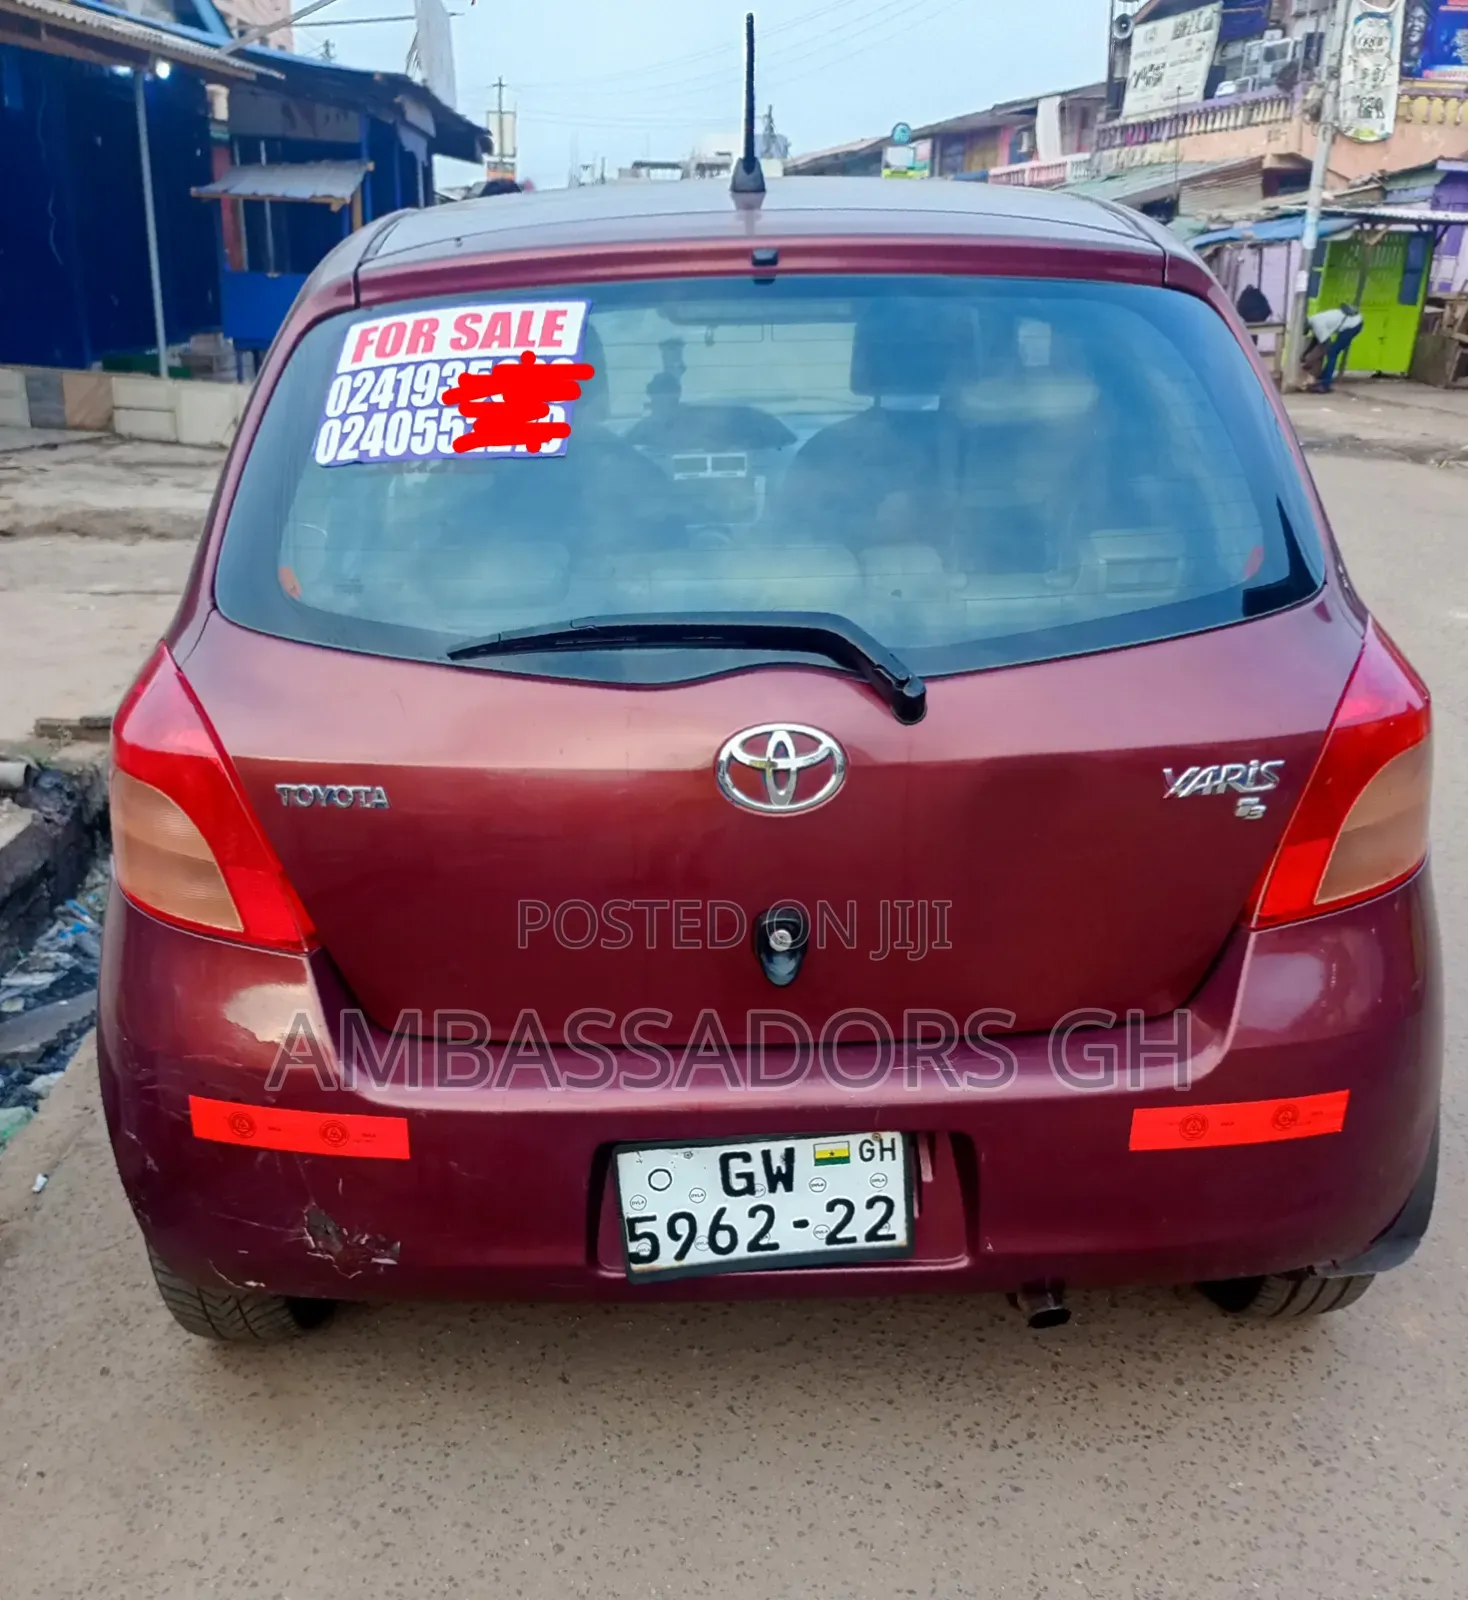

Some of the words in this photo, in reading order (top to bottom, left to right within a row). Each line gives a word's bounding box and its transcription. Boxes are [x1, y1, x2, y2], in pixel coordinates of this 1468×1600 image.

[351, 317, 440, 365] FOR
[449, 309, 568, 351] SALE
[275, 784, 390, 808] TOYOTA
[718, 1146, 796, 1198] GW
[858, 1137, 897, 1163] GH
[625, 1194, 897, 1265] 5962-22
